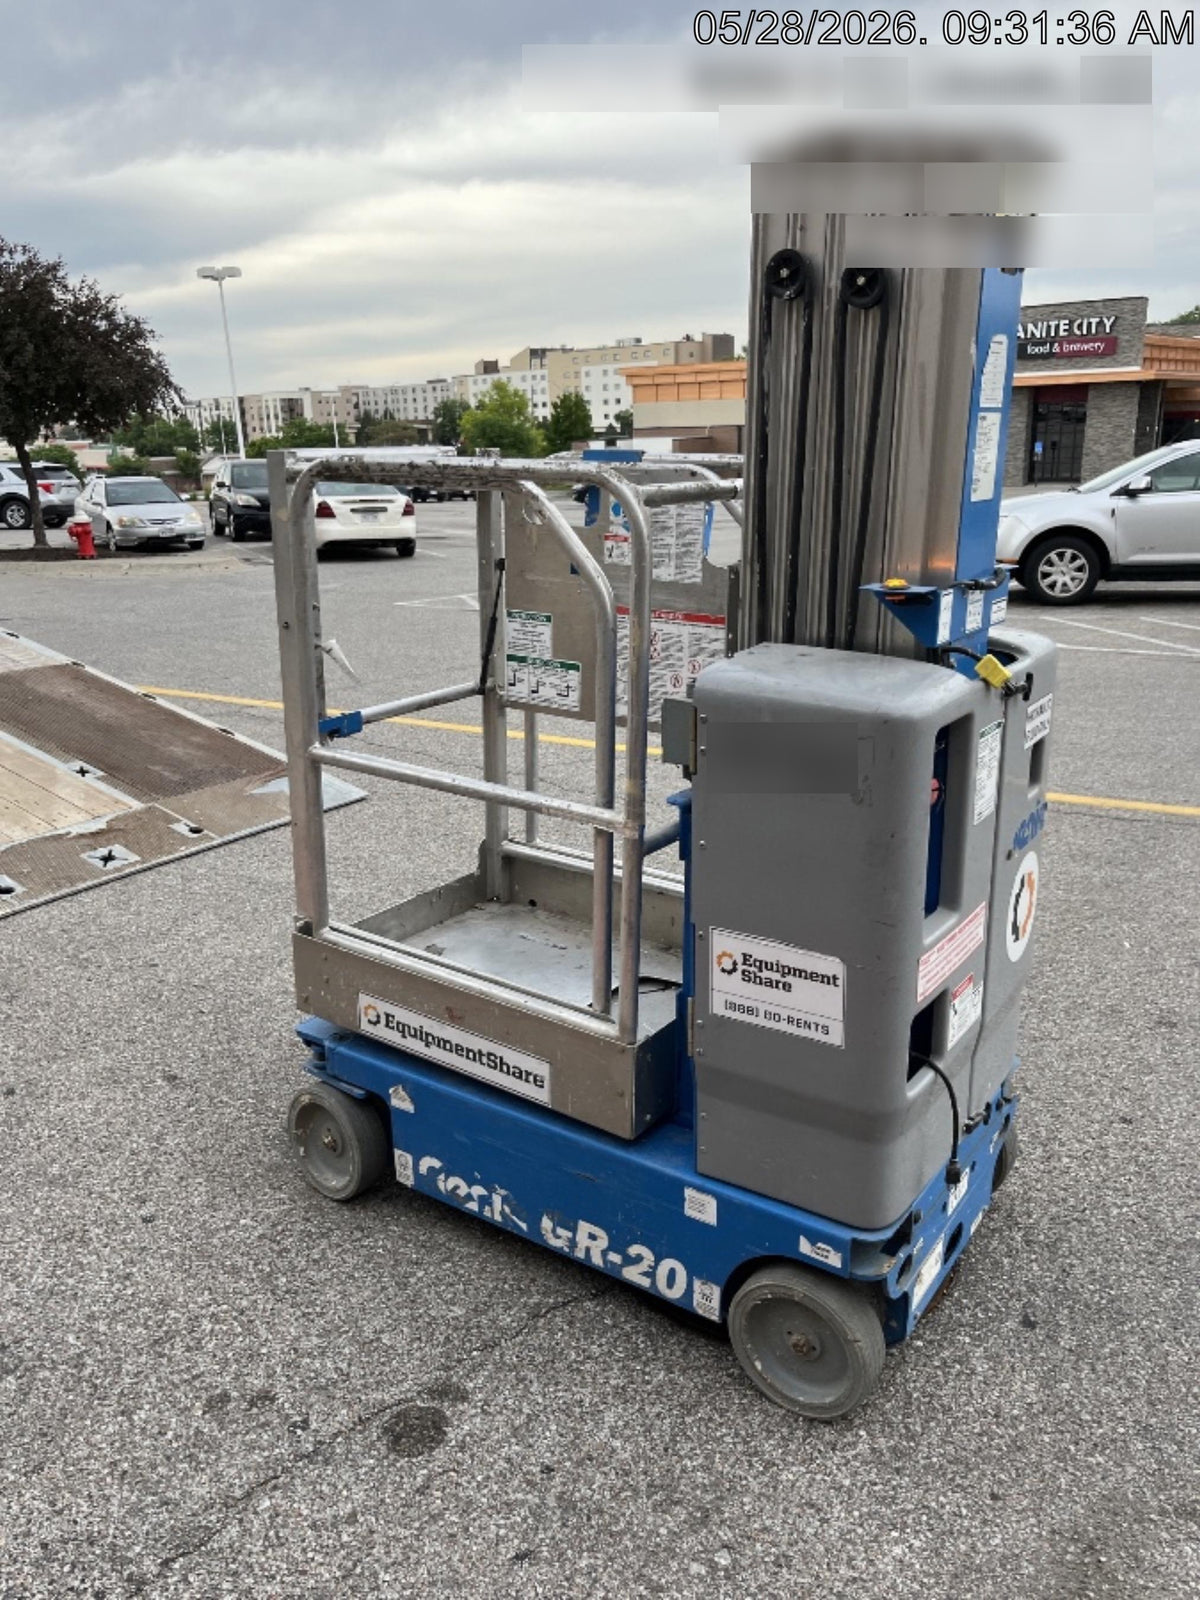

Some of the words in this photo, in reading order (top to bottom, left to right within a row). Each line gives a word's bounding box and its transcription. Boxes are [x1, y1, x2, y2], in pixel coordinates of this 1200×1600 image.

[1017, 319, 1070, 339] ANITE
[1073, 316, 1116, 335] CITY
[1027, 341, 1050, 355] food
[1052, 342, 1061, 353] &
[1062, 340, 1106, 353] brewery
[741, 952, 840, 988] Equipment
[741, 968, 793, 993] Share
[384, 1010, 545, 1090] EquipmentShare
